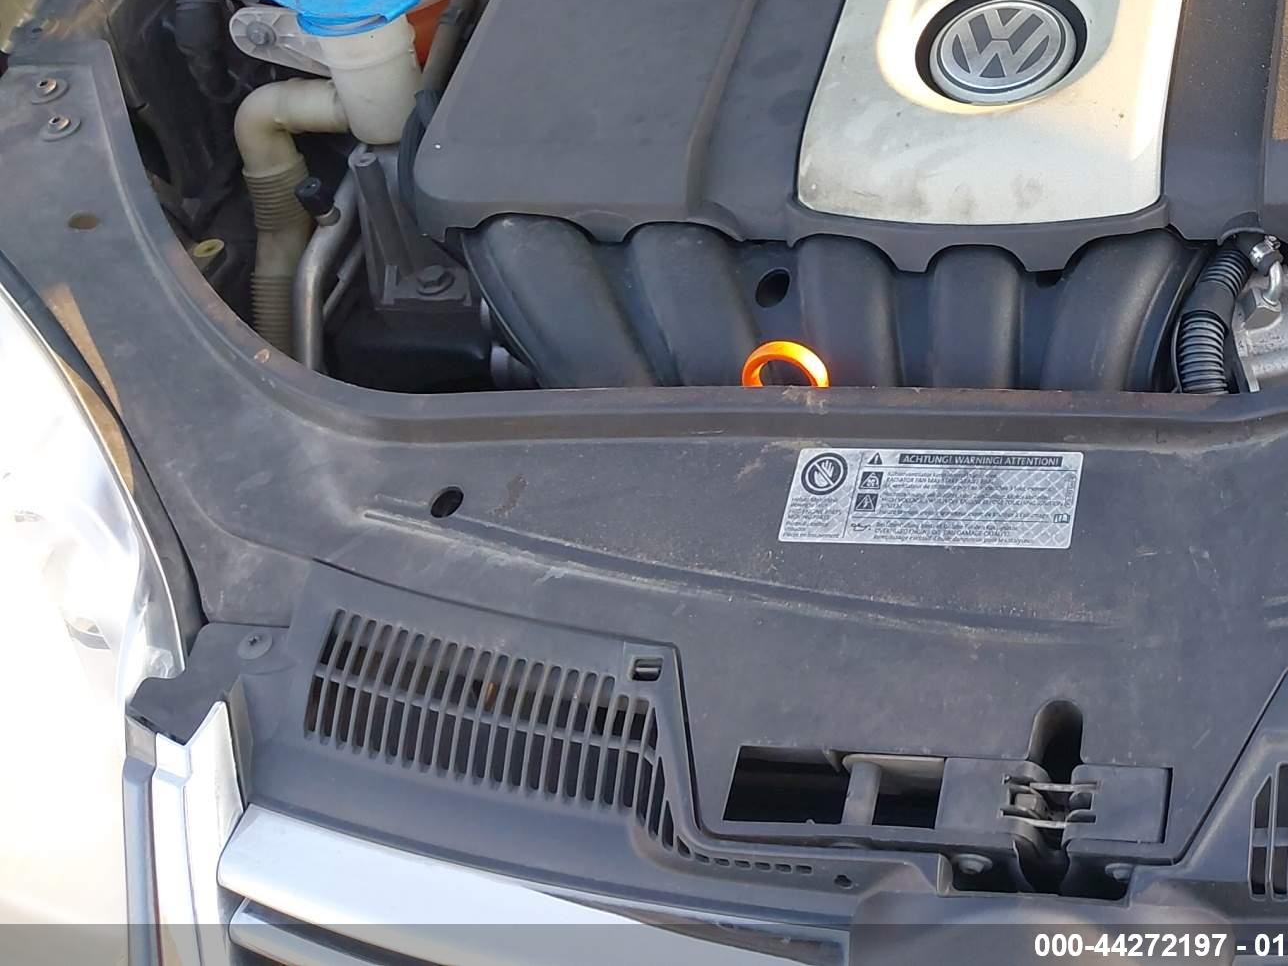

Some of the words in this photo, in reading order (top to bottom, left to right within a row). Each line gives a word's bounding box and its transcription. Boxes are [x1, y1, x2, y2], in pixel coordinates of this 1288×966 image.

[940, 2, 1058, 88] VW
[903, 454, 952, 465] ACHTUNG!
[954, 455, 1003, 466] WARNING!
[1004, 456, 1059, 467] ATTENTION!
